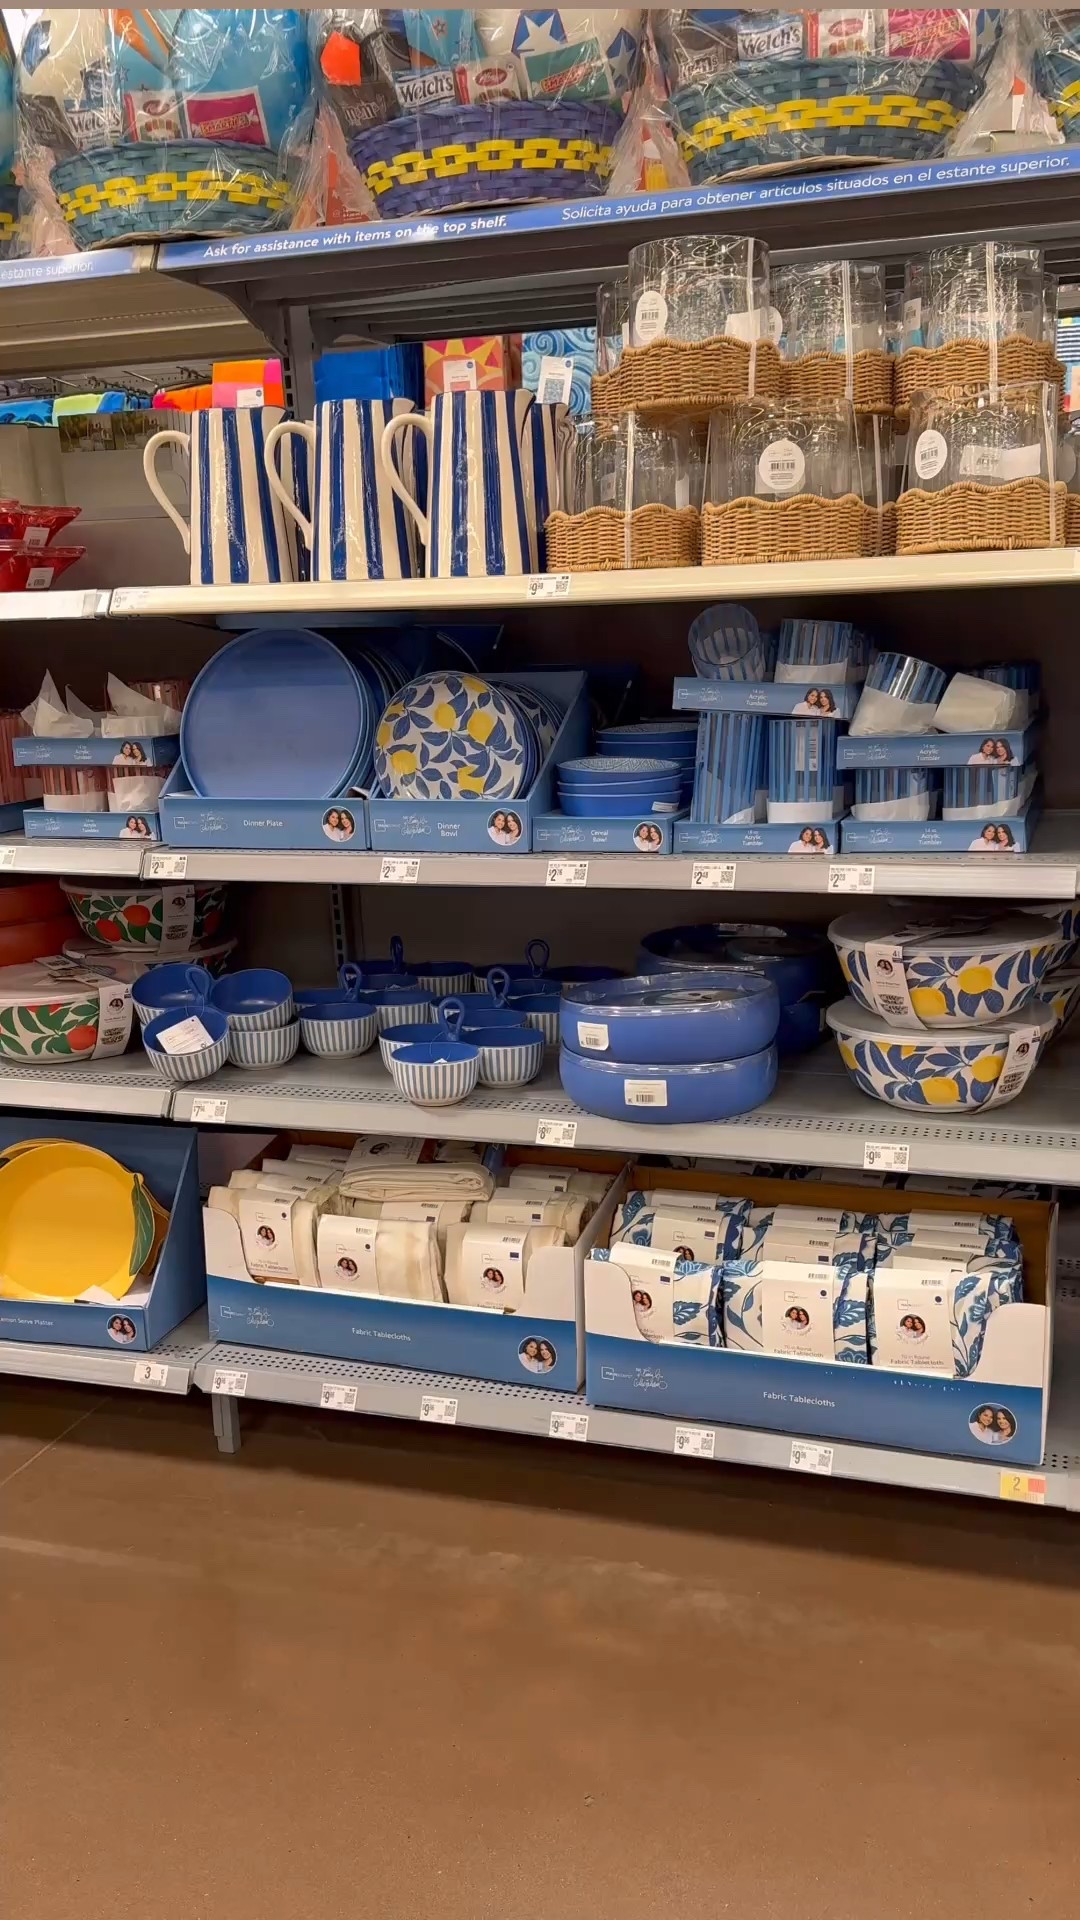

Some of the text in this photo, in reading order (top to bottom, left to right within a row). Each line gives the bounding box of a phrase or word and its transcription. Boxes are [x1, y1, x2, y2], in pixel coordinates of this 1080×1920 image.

[741, 25, 801, 55] Welch's
[400, 74, 454, 103] Welch's
[562, 156, 1070, 221] Solicita ayuda para obtener artículos situados en el estante superior.
[203, 215, 507, 258] Ask for assistance with items on the top shelf.
[1, 261, 94, 280] estante superior.
[352, 1327, 411, 1341] Fabric Tablecloths
[144, 1366, 152, 1379] 3
[763, 1391, 836, 1408] Fabric Tablecloths
[1013, 1476, 1021, 1491] 2
